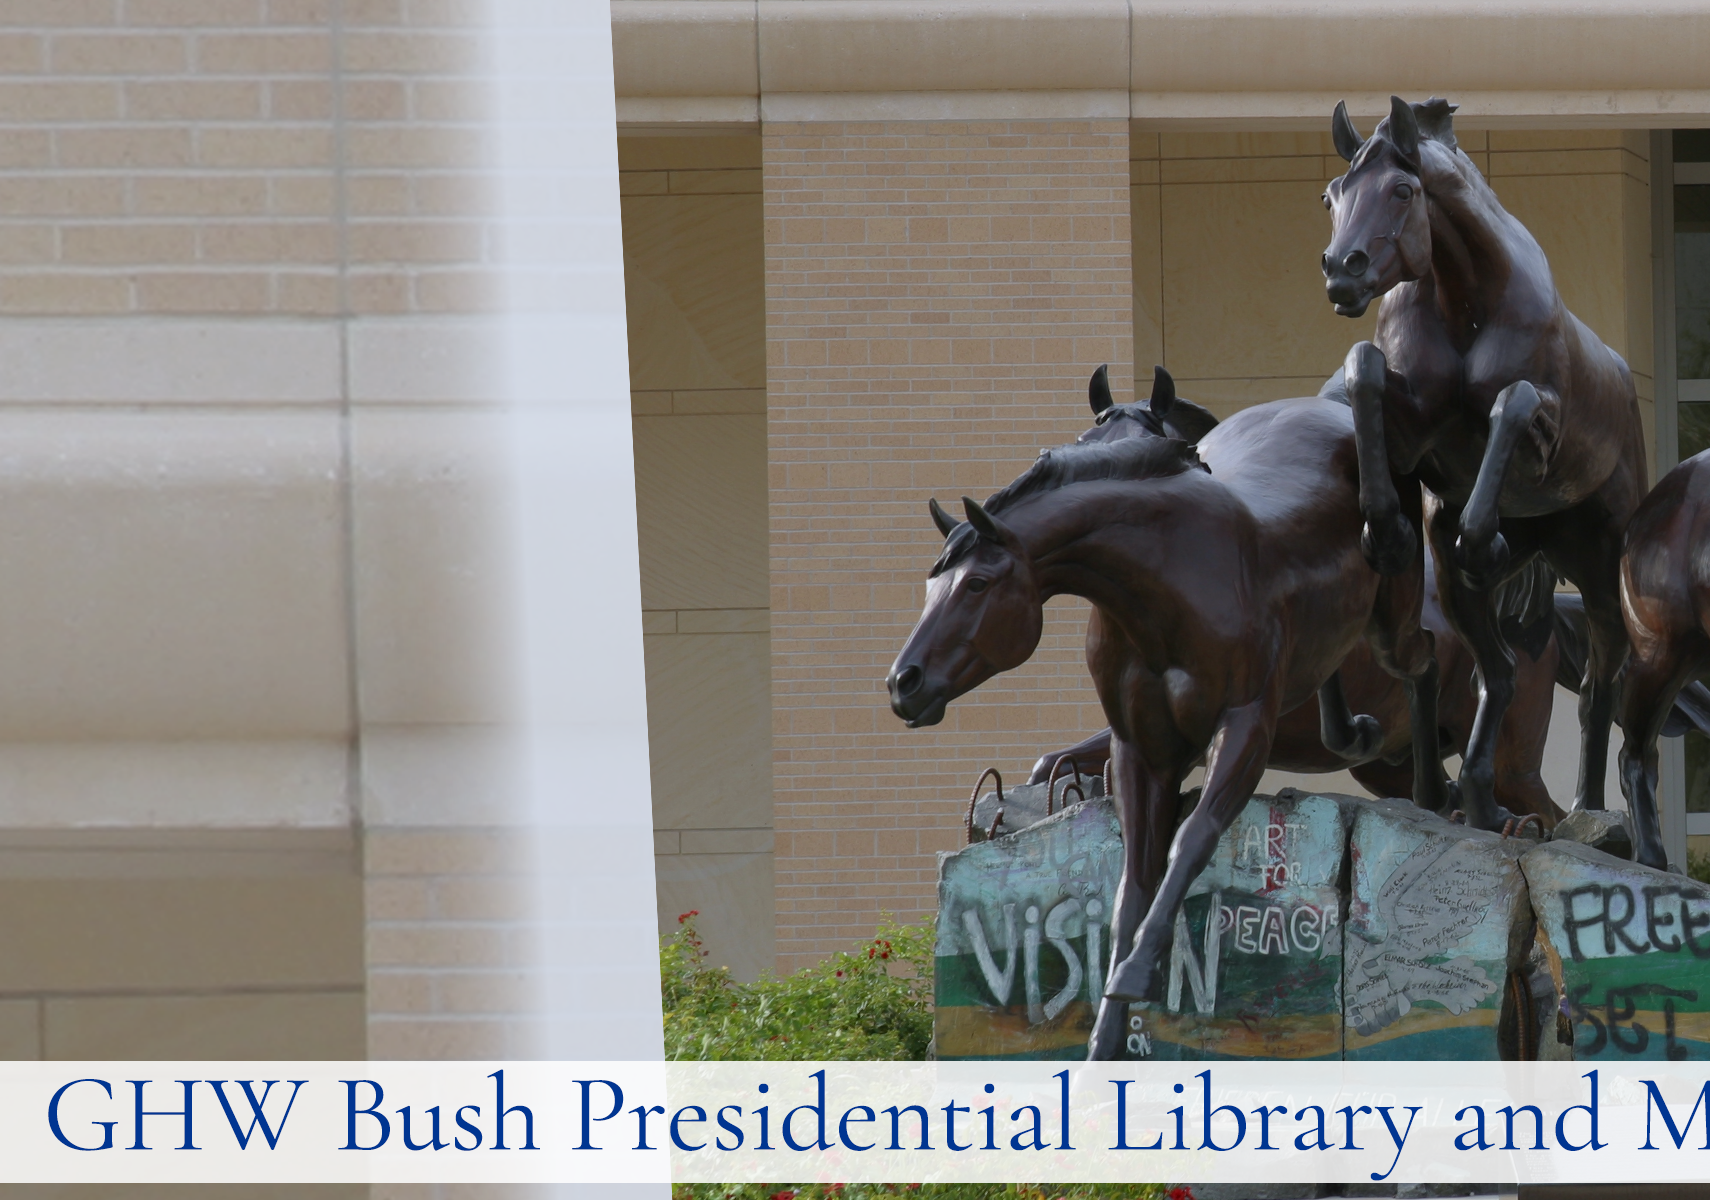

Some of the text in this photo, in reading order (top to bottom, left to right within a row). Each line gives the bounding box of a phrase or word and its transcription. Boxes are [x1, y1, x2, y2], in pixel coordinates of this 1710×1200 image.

[1243, 823, 1307, 860] ART
[1258, 862, 1302, 889] FOR
[1569, 981, 1698, 1063] SET
